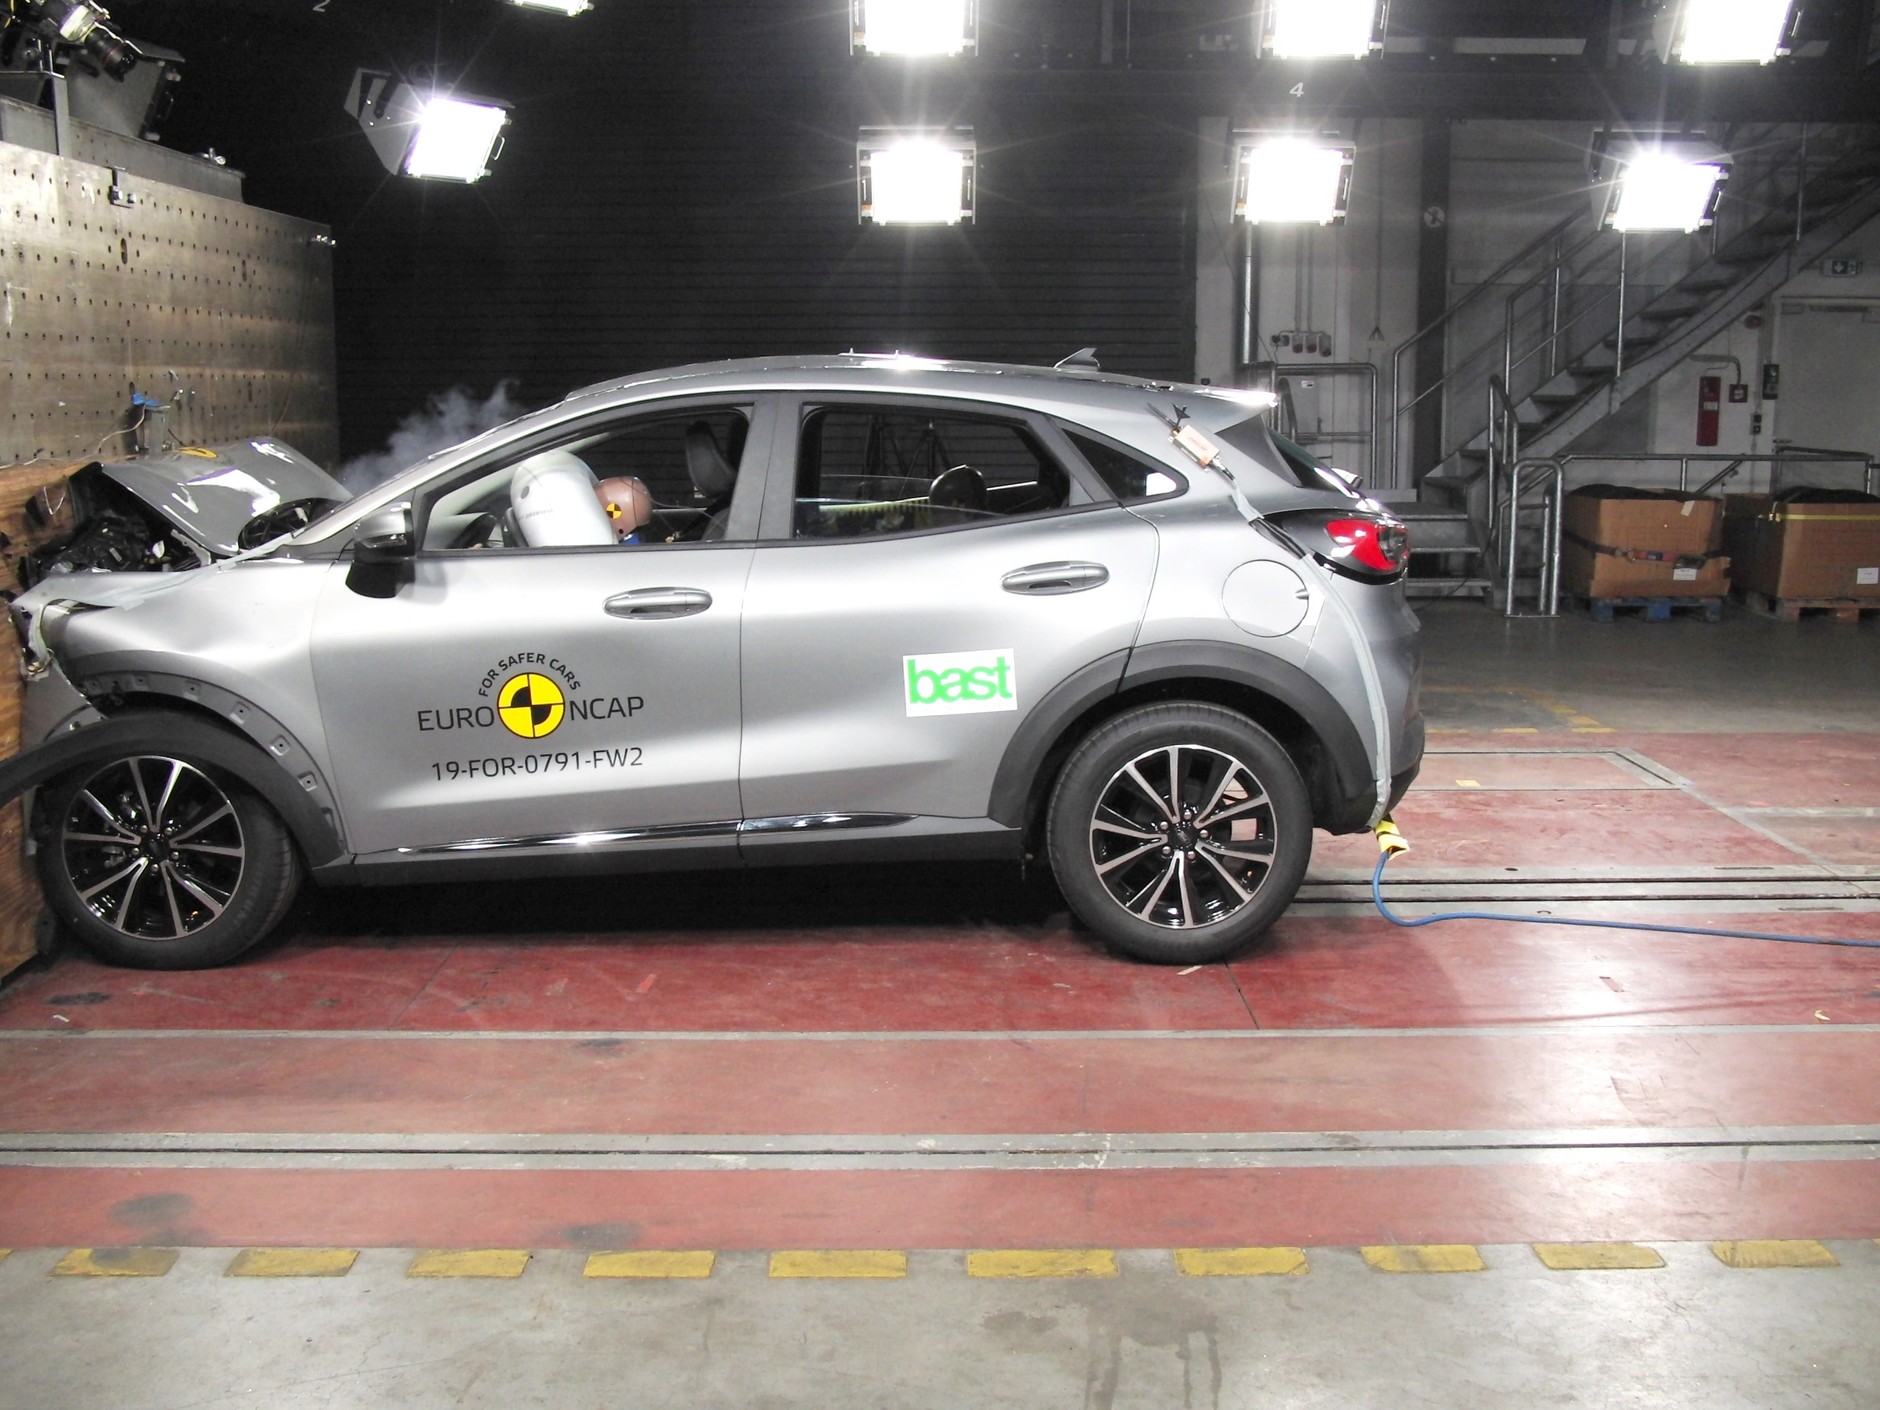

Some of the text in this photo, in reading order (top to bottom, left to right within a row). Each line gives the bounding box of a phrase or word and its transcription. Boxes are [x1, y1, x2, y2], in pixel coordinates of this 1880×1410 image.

[1289, 82, 1304, 97] 4
[478, 652, 581, 697] FOR SAFER CARS
[907, 656, 1012, 704] bast
[417, 696, 644, 731] EURO NCAP
[432, 747, 643, 781] 19-FOR-0791-FW2
